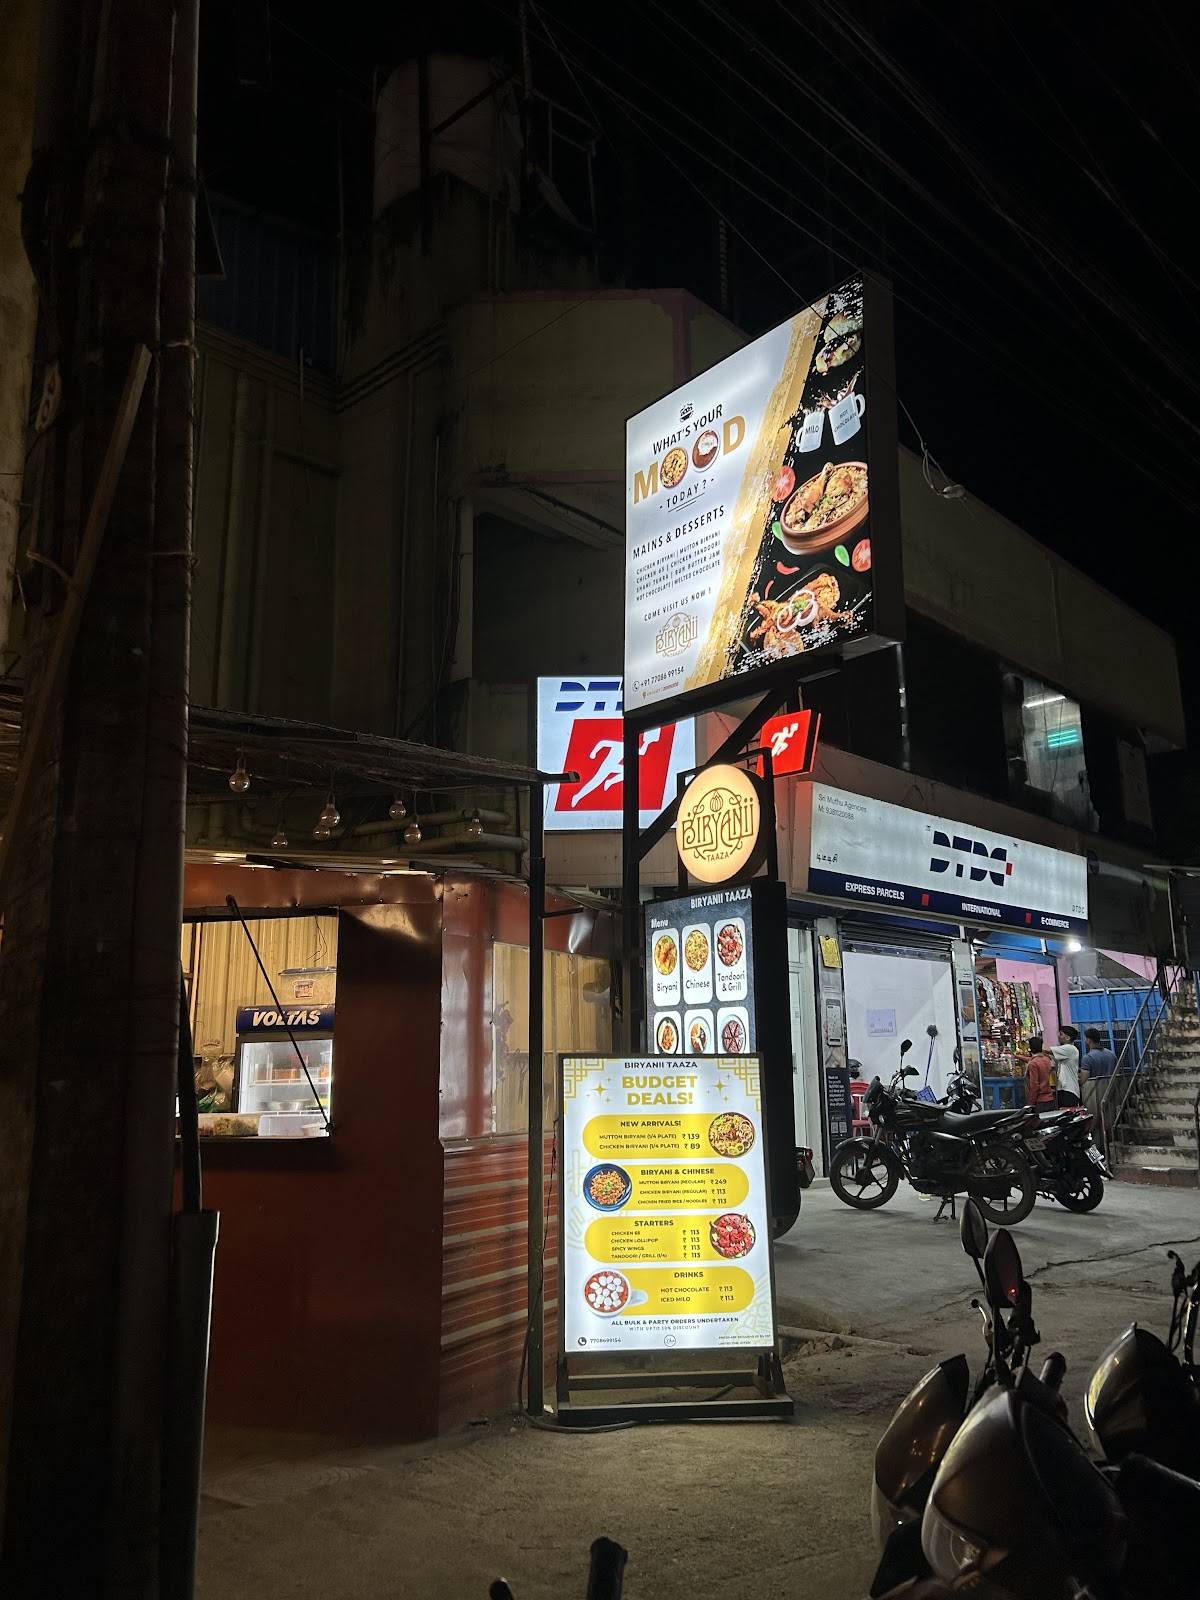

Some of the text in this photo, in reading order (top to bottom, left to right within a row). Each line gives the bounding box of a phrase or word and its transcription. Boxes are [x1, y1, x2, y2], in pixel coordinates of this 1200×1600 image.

[652, 404, 723, 456] WHAT'S YOUR
[805, 426, 820, 434] MILO
[632, 505, 724, 560] MAINS & DESSERTS
[636, 530, 720, 575] CHICKEN BIRYANI MUTTON BIRYANI
[687, 556, 707, 569] BUTTER
[709, 550, 720, 559] JAM
[636, 570, 656, 584] CHICKEN
[670, 554, 692, 567] CHICKEN
[694, 539, 720, 557] TANDOORI
[646, 582, 670, 598] CHOCOLATE
[674, 572, 692, 584] MELTED
[693, 559, 720, 577] CHOCOLATE
[644, 609, 660, 621] COME
[662, 602, 678, 613] VISIT
[680, 596, 688, 606] US
[641, 666, 684, 686] +91 77086 99154
[707, 852, 729, 861] TAAZA
[930, 830, 1012, 886] DTDC
[690, 888, 752, 909] BIRYANII TAAZA
[845, 882, 905, 900] EXPRESS PARCELS
[962, 902, 1002, 918] INTERNATIONAL
[1072, 905, 1085, 914] DTDC
[651, 919, 669, 928] Menu
[1040, 916, 1069, 928] E-COMMERCE
[685, 979, 710, 989] Chinese
[717, 970, 745, 982] Tandoori
[656, 981, 678, 993] Biryani
[722, 982, 742, 992] & Grill
[252, 1010, 321, 1027] VOLTAS
[622, 1076, 697, 1089] BUDGET
[627, 1092, 693, 1105] DEALS!
